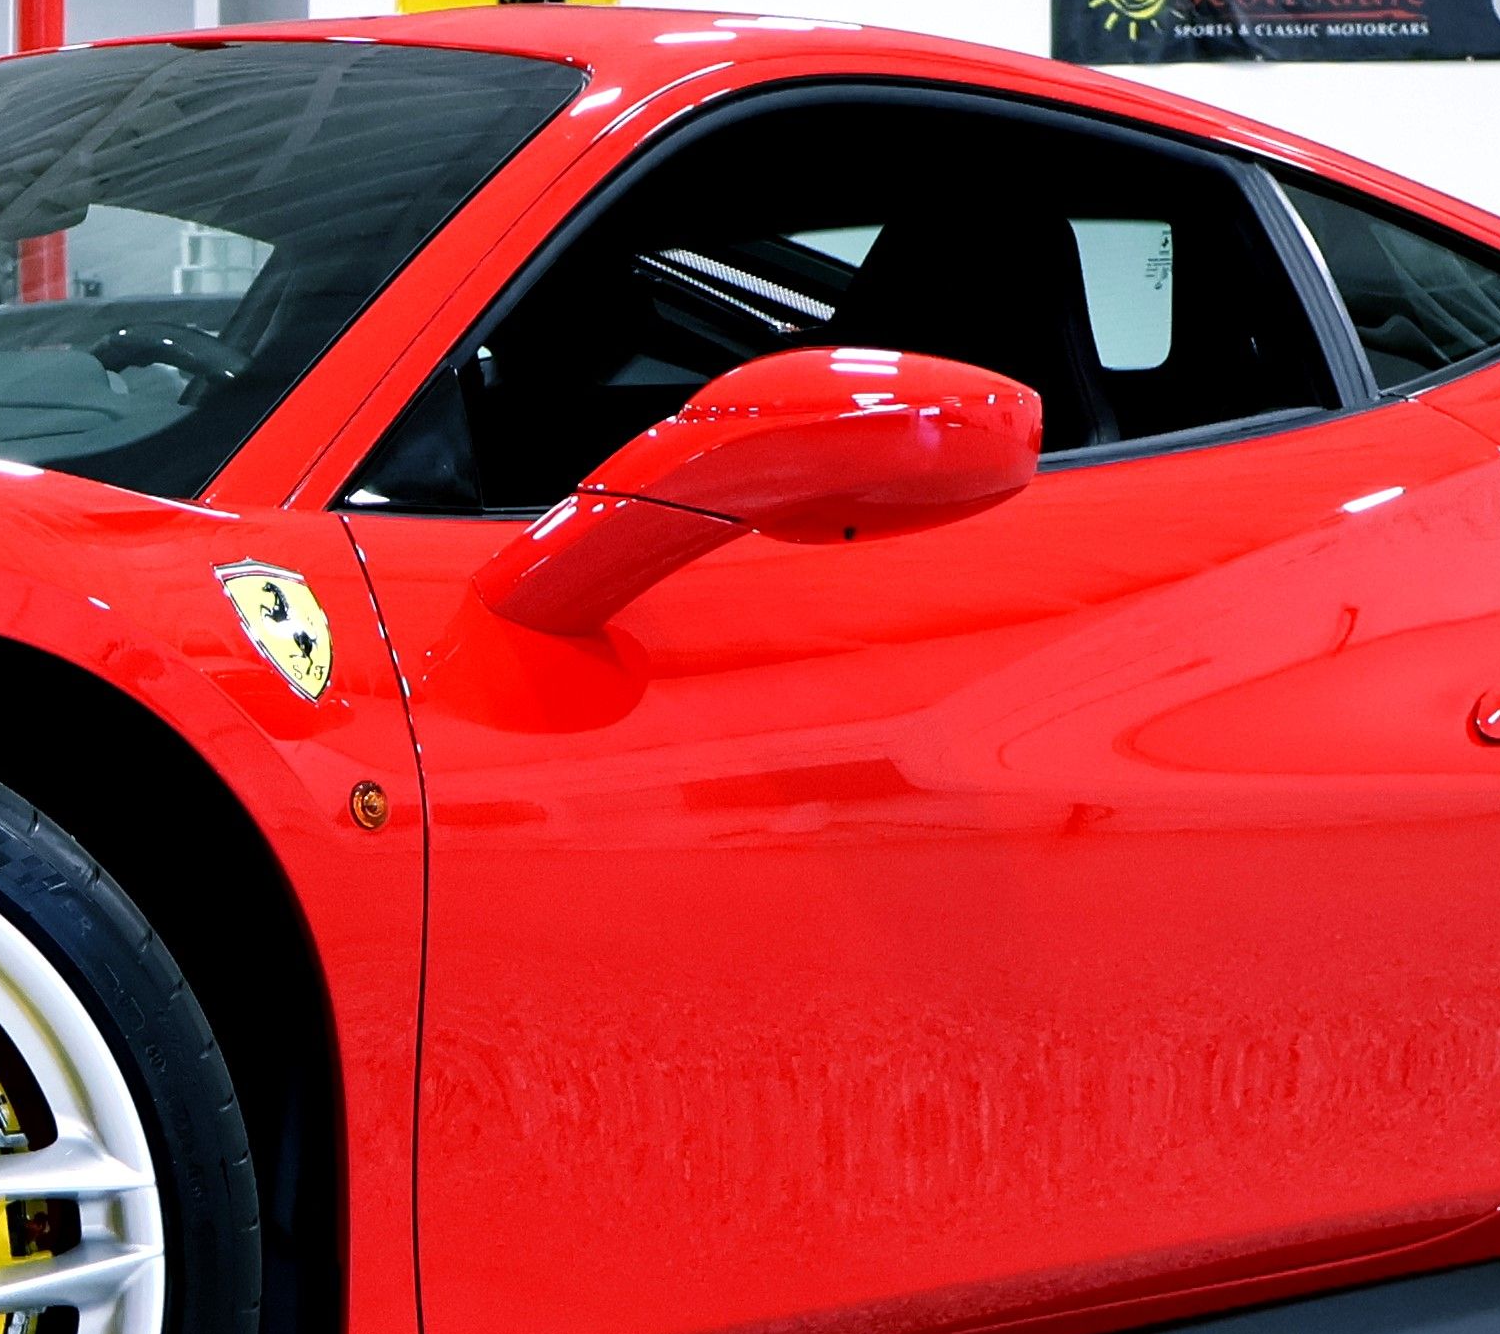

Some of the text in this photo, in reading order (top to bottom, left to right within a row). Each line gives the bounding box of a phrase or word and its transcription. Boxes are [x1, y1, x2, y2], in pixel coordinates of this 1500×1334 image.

[1174, 22, 1430, 38] SPORTS & CLASSIC MOTORCARS
